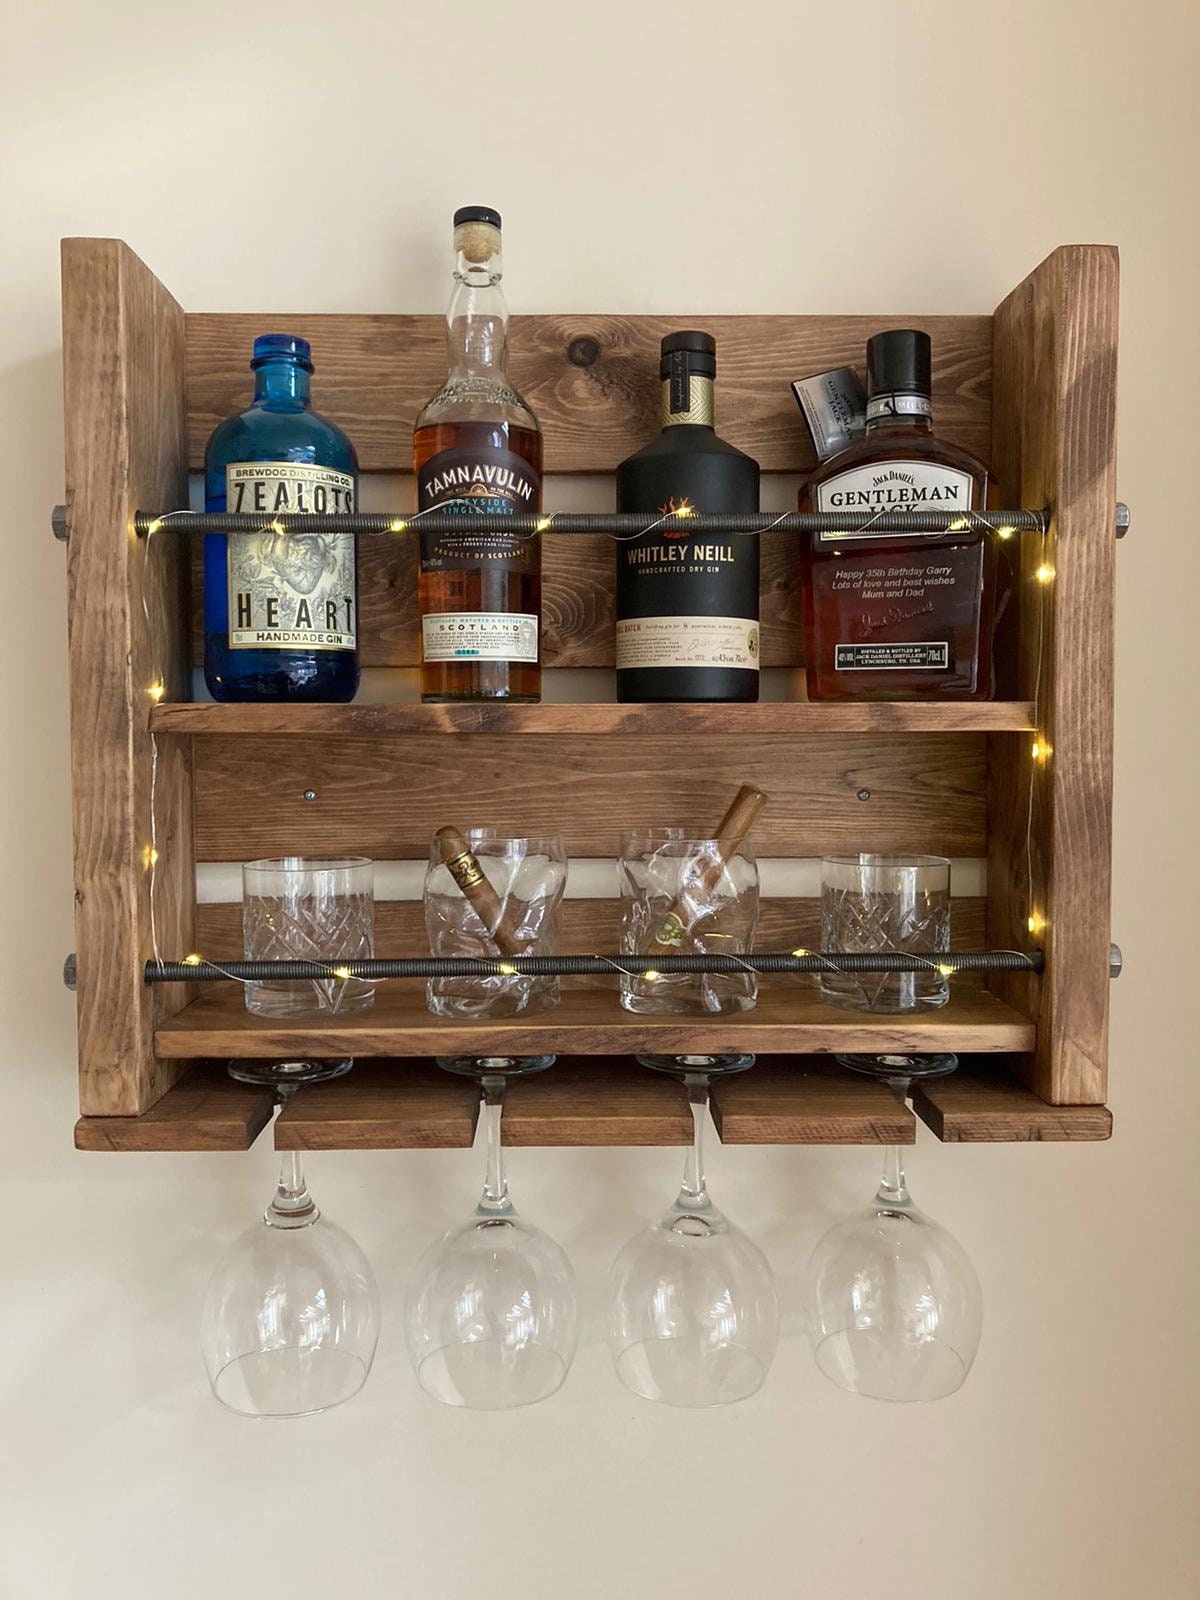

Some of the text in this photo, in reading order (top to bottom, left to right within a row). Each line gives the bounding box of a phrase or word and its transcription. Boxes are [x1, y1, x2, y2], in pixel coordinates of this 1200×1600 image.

[235, 468, 288, 478] BREWDOG
[289, 469, 340, 482] DISTILLING
[425, 464, 532, 501] TAMNAVULIN
[872, 473, 889, 488] JACK
[234, 481, 353, 514] ZEALOTS
[830, 485, 959, 507] GENTLEMAN
[628, 545, 735, 565] WHITLEY NEILL
[638, 566, 686, 575] HANDCRAFTED
[835, 570, 865, 580] Happy
[866, 568, 886, 578] 35th
[888, 567, 925, 578] Birthday
[832, 575, 955, 590] Lots of love and best wishes
[862, 587, 924, 599] Mum and Dad
[238, 593, 352, 632] HEART
[256, 632, 343, 644] HANDMADE GIN
